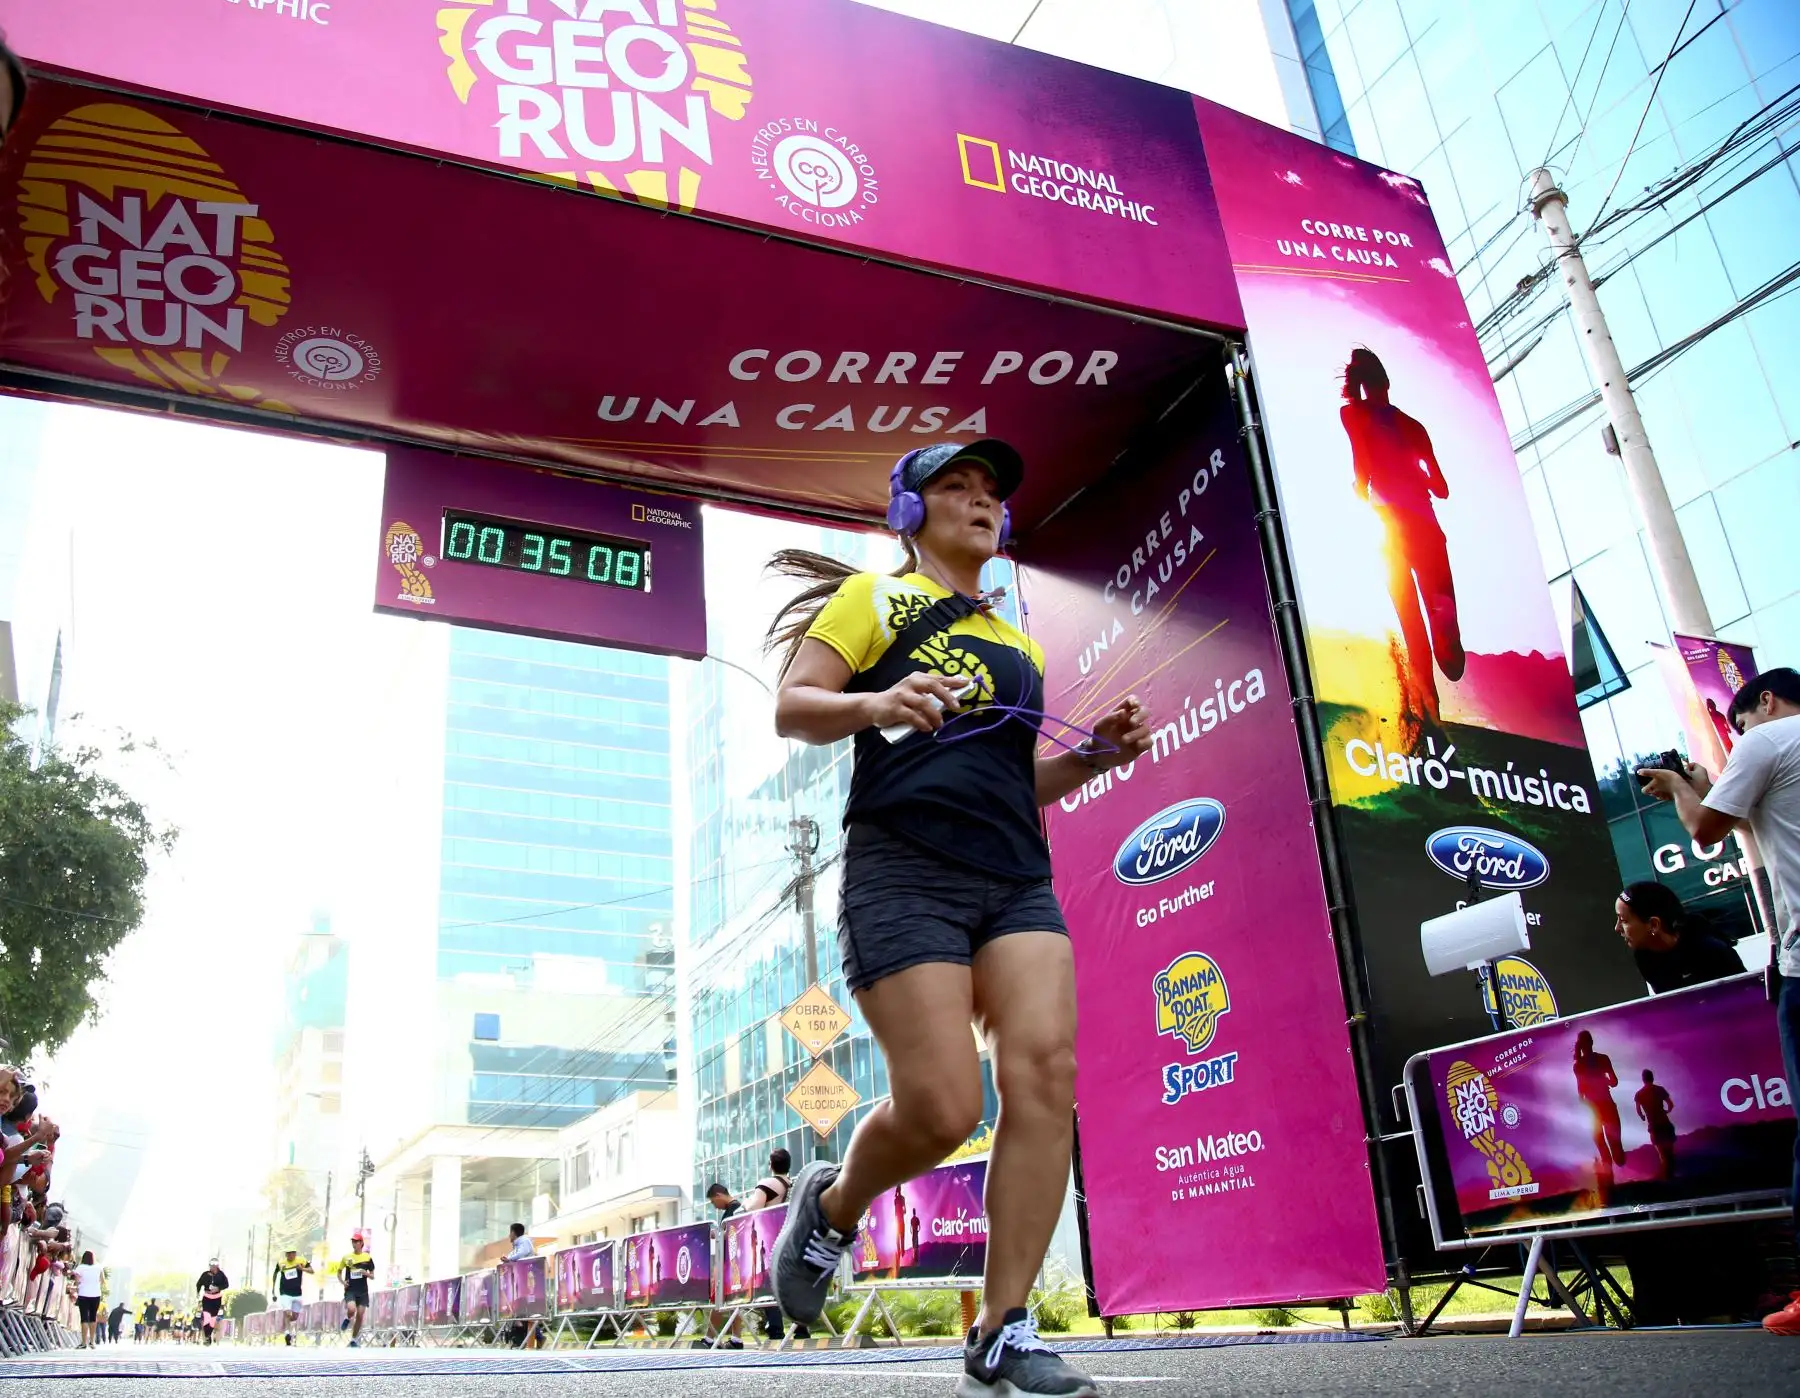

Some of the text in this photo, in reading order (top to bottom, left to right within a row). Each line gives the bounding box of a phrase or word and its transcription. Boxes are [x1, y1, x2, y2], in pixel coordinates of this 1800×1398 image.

[468, 15, 688, 93] GEO
[490, 84, 713, 165] RUN
[751, 117, 879, 204] NEUTROS EN CARBONO
[1008, 148, 1124, 196] NATIONAL
[774, 194, 864, 227] ACCIONA
[1011, 175, 1159, 226] GEOGRAPHIC
[74, 191, 259, 257] NAT
[1301, 218, 1414, 248] CORRE POR
[1277, 240, 1398, 269] UNA CAUSA
[52, 244, 236, 305] GEO
[71, 293, 244, 353] RUN
[274, 326, 382, 382] NEUTROS EN CARBONO
[727, 348, 1118, 386] CORRE POR
[287, 371, 360, 390] ACCIONA
[596, 395, 988, 434] UNA CAUSA
[646, 508, 682, 520] NATIONAL
[646, 515, 692, 529] GEOGRAPHIC
[1104, 448, 1227, 605] CORRE POR
[390, 543, 416, 554] GEO
[393, 533, 418, 545] NAT
[448, 521, 640, 587] 00 35 08
[391, 552, 417, 564] RUN
[887, 593, 933, 610] NAT
[1078, 524, 1204, 676] UNA CAUSA
[888, 606, 922, 631] GE
[1136, 815, 1202, 875] Ford
[1453, 835, 1525, 880] Ford
[1136, 880, 1215, 928] Go Further
[1157, 966, 1217, 1006] BANANA
[1484, 968, 1545, 993] ANANA
[795, 1004, 836, 1016] OBRAS
[1171, 990, 1210, 1030] BOAT
[1501, 990, 1538, 1016] BOAT
[793, 1020, 838, 1031] A 150 M
[1487, 1052, 1527, 1077] UNA CAUSA
[1494, 1037, 1534, 1062] CORRE POR
[800, 1085, 845, 1096] DISMINUIR
[1162, 1052, 1238, 1105] SPORT
[1455, 1073, 1485, 1104] NAT
[798, 1099, 848, 1110] VELOCIDAD
[1456, 1093, 1488, 1121] GEO
[1462, 1107, 1495, 1139] RUN
[1155, 1130, 1262, 1172] San Mateo
[1171, 1176, 1255, 1201] DE MANANTIAL
[1178, 1163, 1245, 1185] Auténtica Agua
[1494, 1190, 1511, 1198] LIMA
